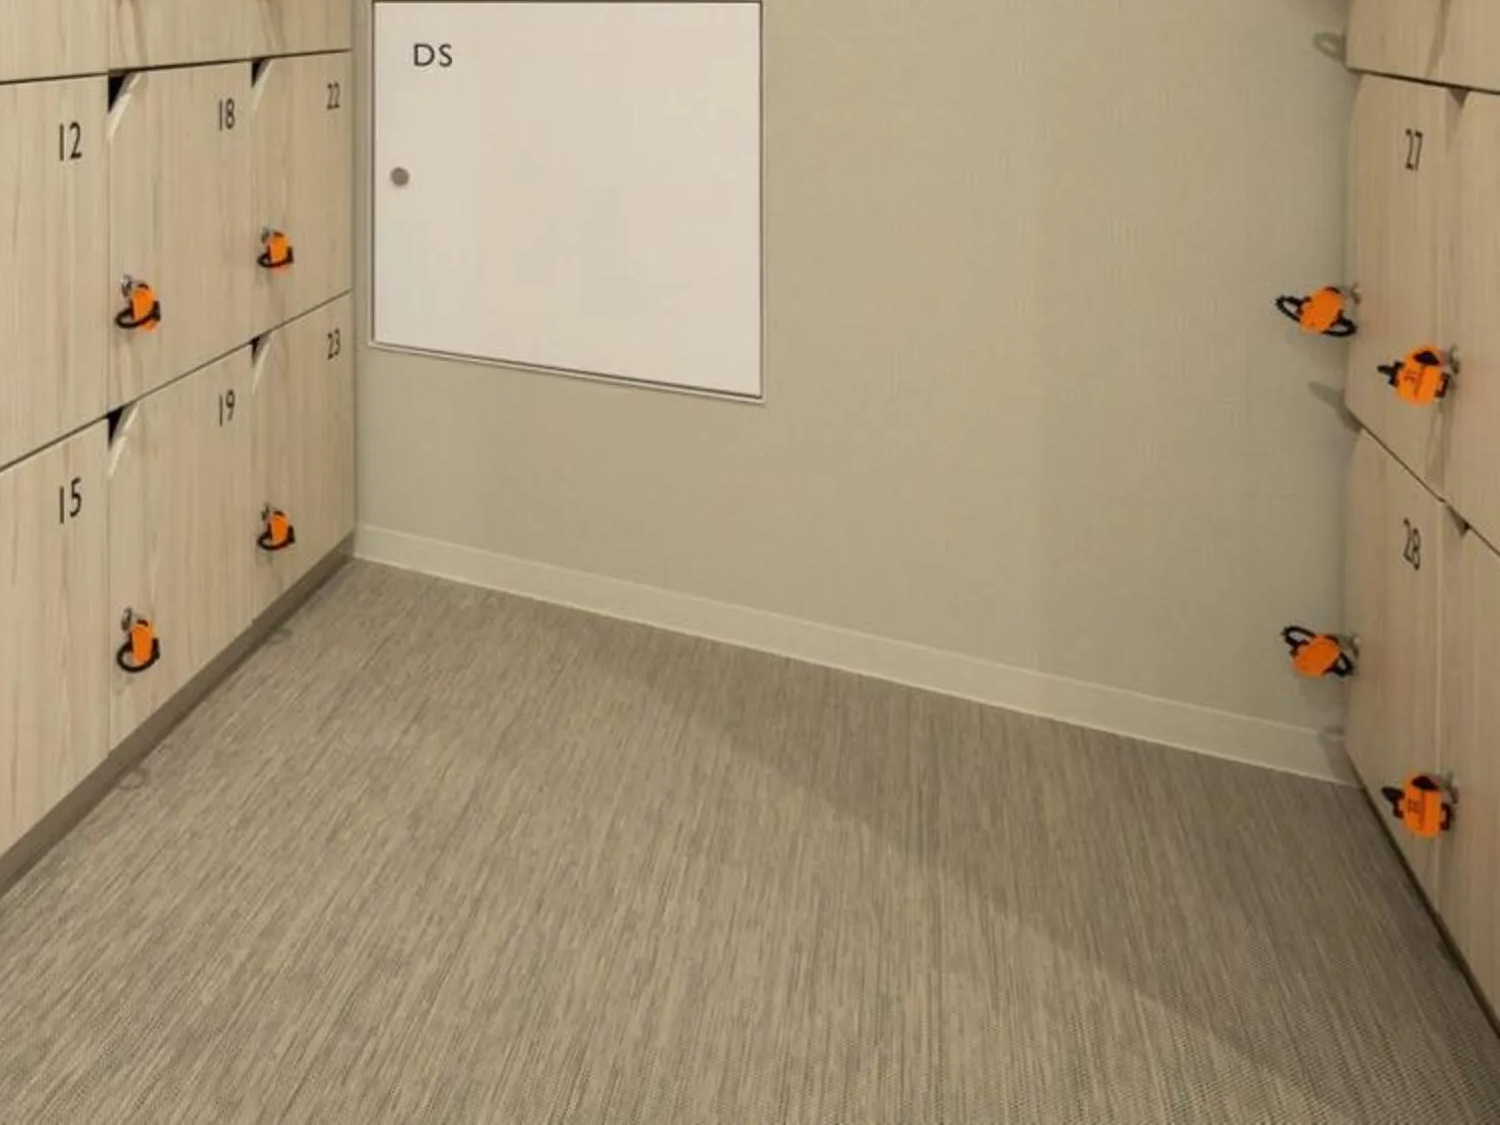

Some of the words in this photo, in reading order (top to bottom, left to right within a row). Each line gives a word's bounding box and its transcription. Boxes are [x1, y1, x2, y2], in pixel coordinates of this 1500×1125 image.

[413, 42, 453, 68] DS
[218, 97, 236, 131] 18
[326, 81, 341, 111] 22
[59, 121, 83, 162] 12
[1405, 128, 1424, 171] 27
[326, 327, 341, 361] 23
[219, 389, 236, 427] 19
[59, 476, 82, 524] 15
[1402, 517, 1421, 572] 28
